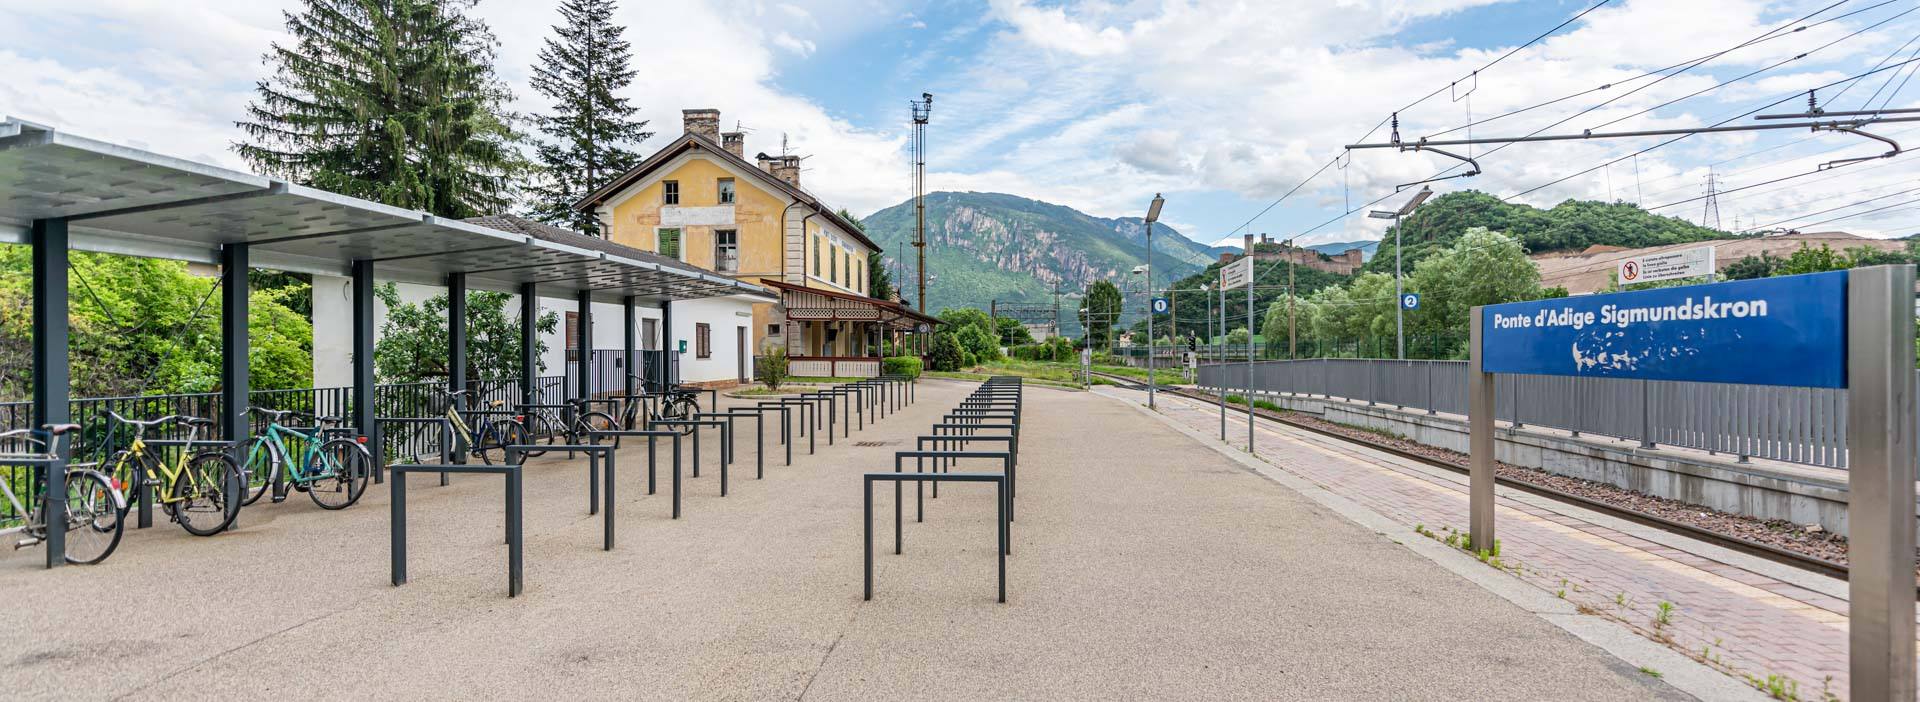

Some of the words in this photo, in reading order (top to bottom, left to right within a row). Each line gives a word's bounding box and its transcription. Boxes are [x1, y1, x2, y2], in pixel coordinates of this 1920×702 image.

[1407, 297, 1414, 306] 2
[1494, 313, 1531, 328] Ponte
[1534, 307, 1595, 329] d'Adige
[1600, 296, 1767, 328] Sigmundskron
